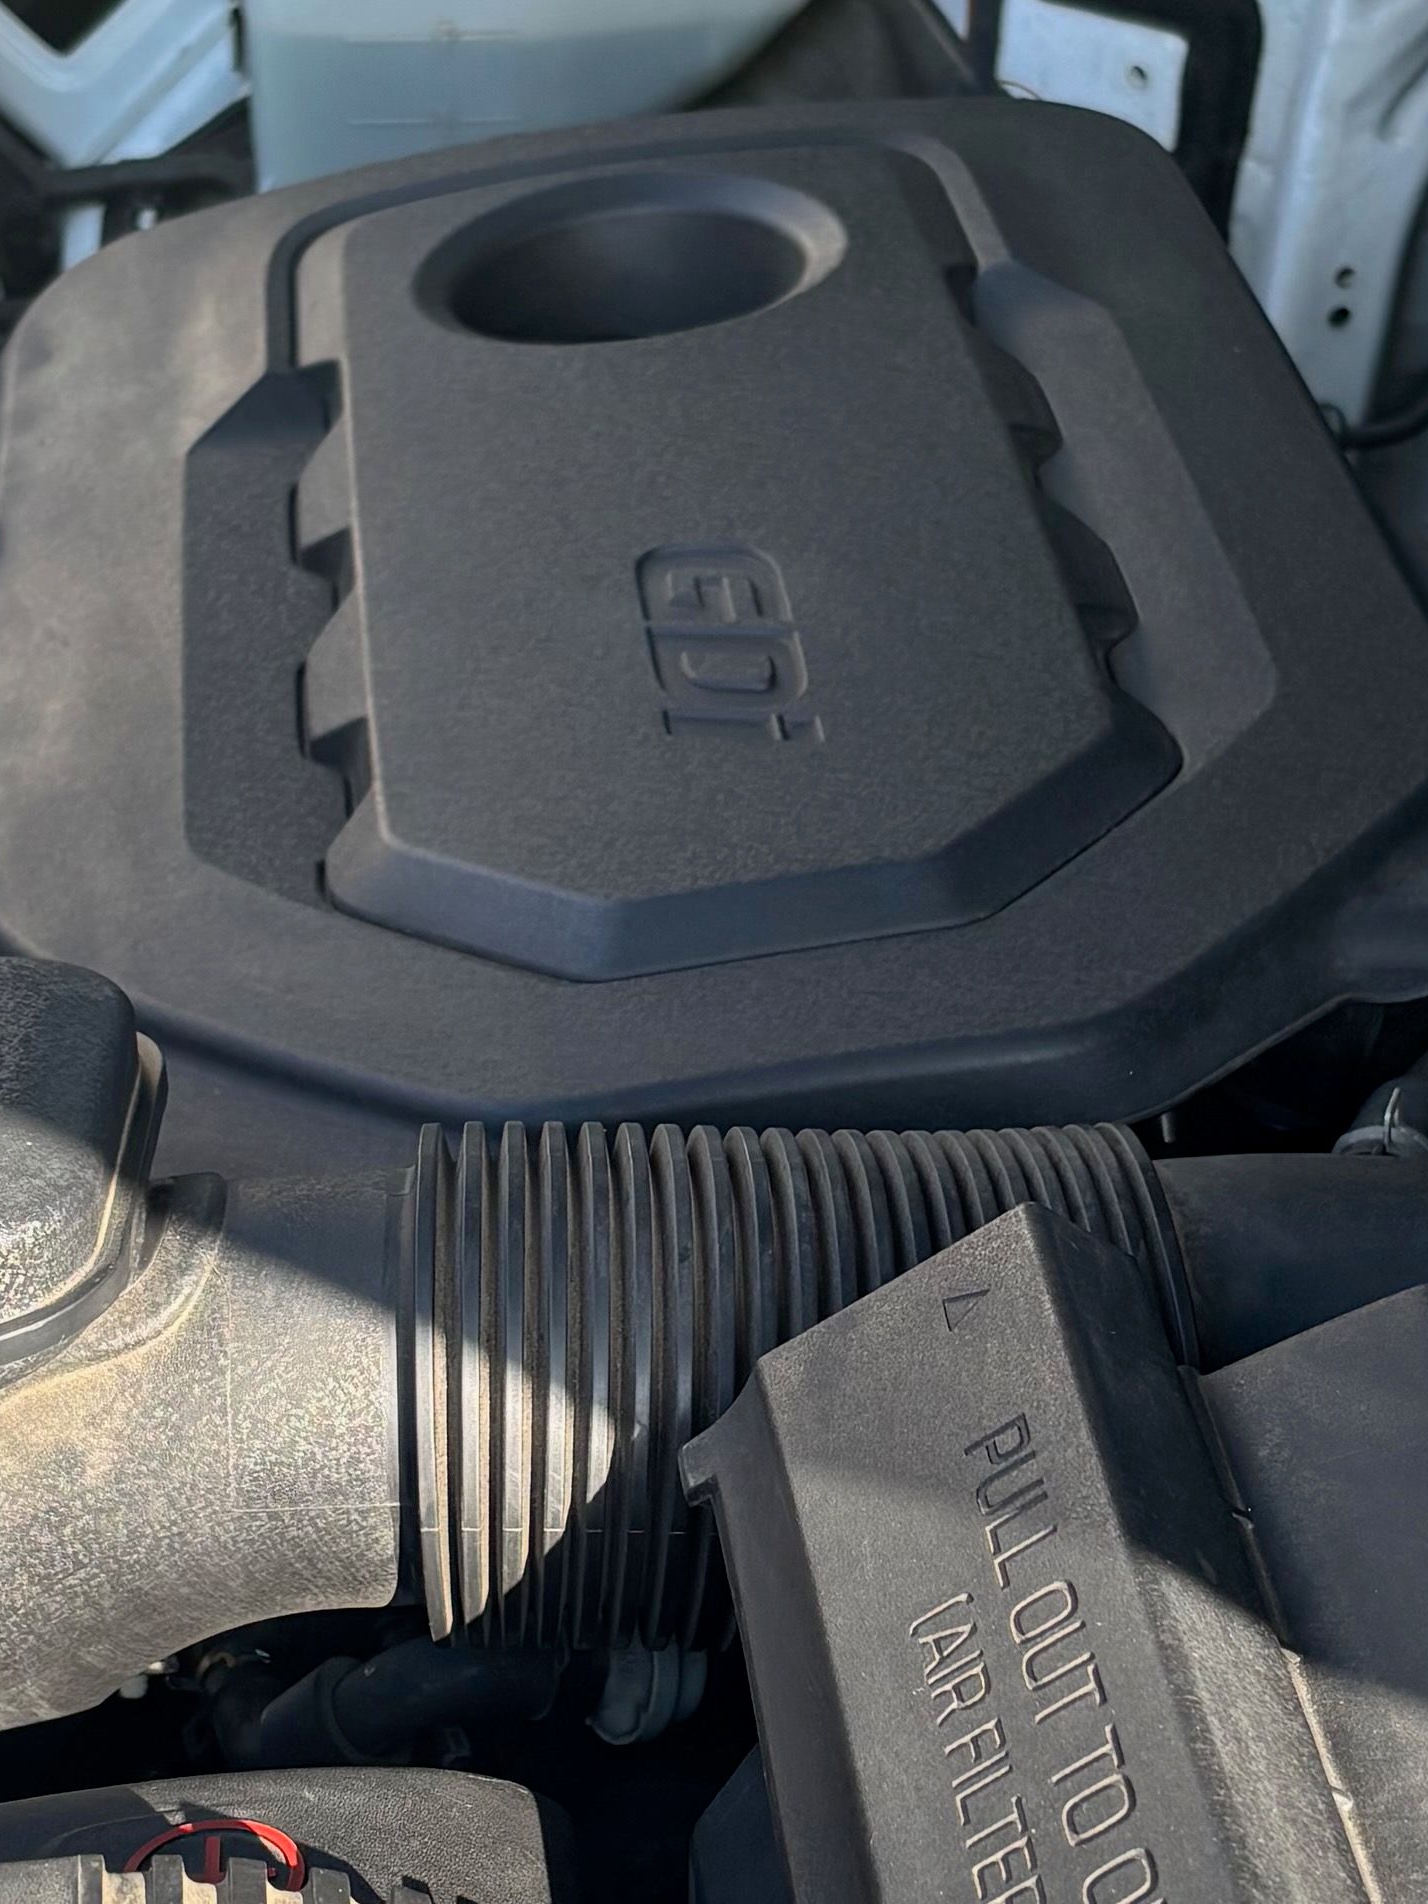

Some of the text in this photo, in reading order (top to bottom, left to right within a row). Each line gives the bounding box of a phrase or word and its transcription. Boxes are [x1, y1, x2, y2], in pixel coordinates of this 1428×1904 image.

[964, 1412, 1058, 1589] PULL
[908, 1593, 993, 1726] (AIR
[1009, 1579, 1108, 1724] OUT
[1050, 1723, 1137, 1846] TO
